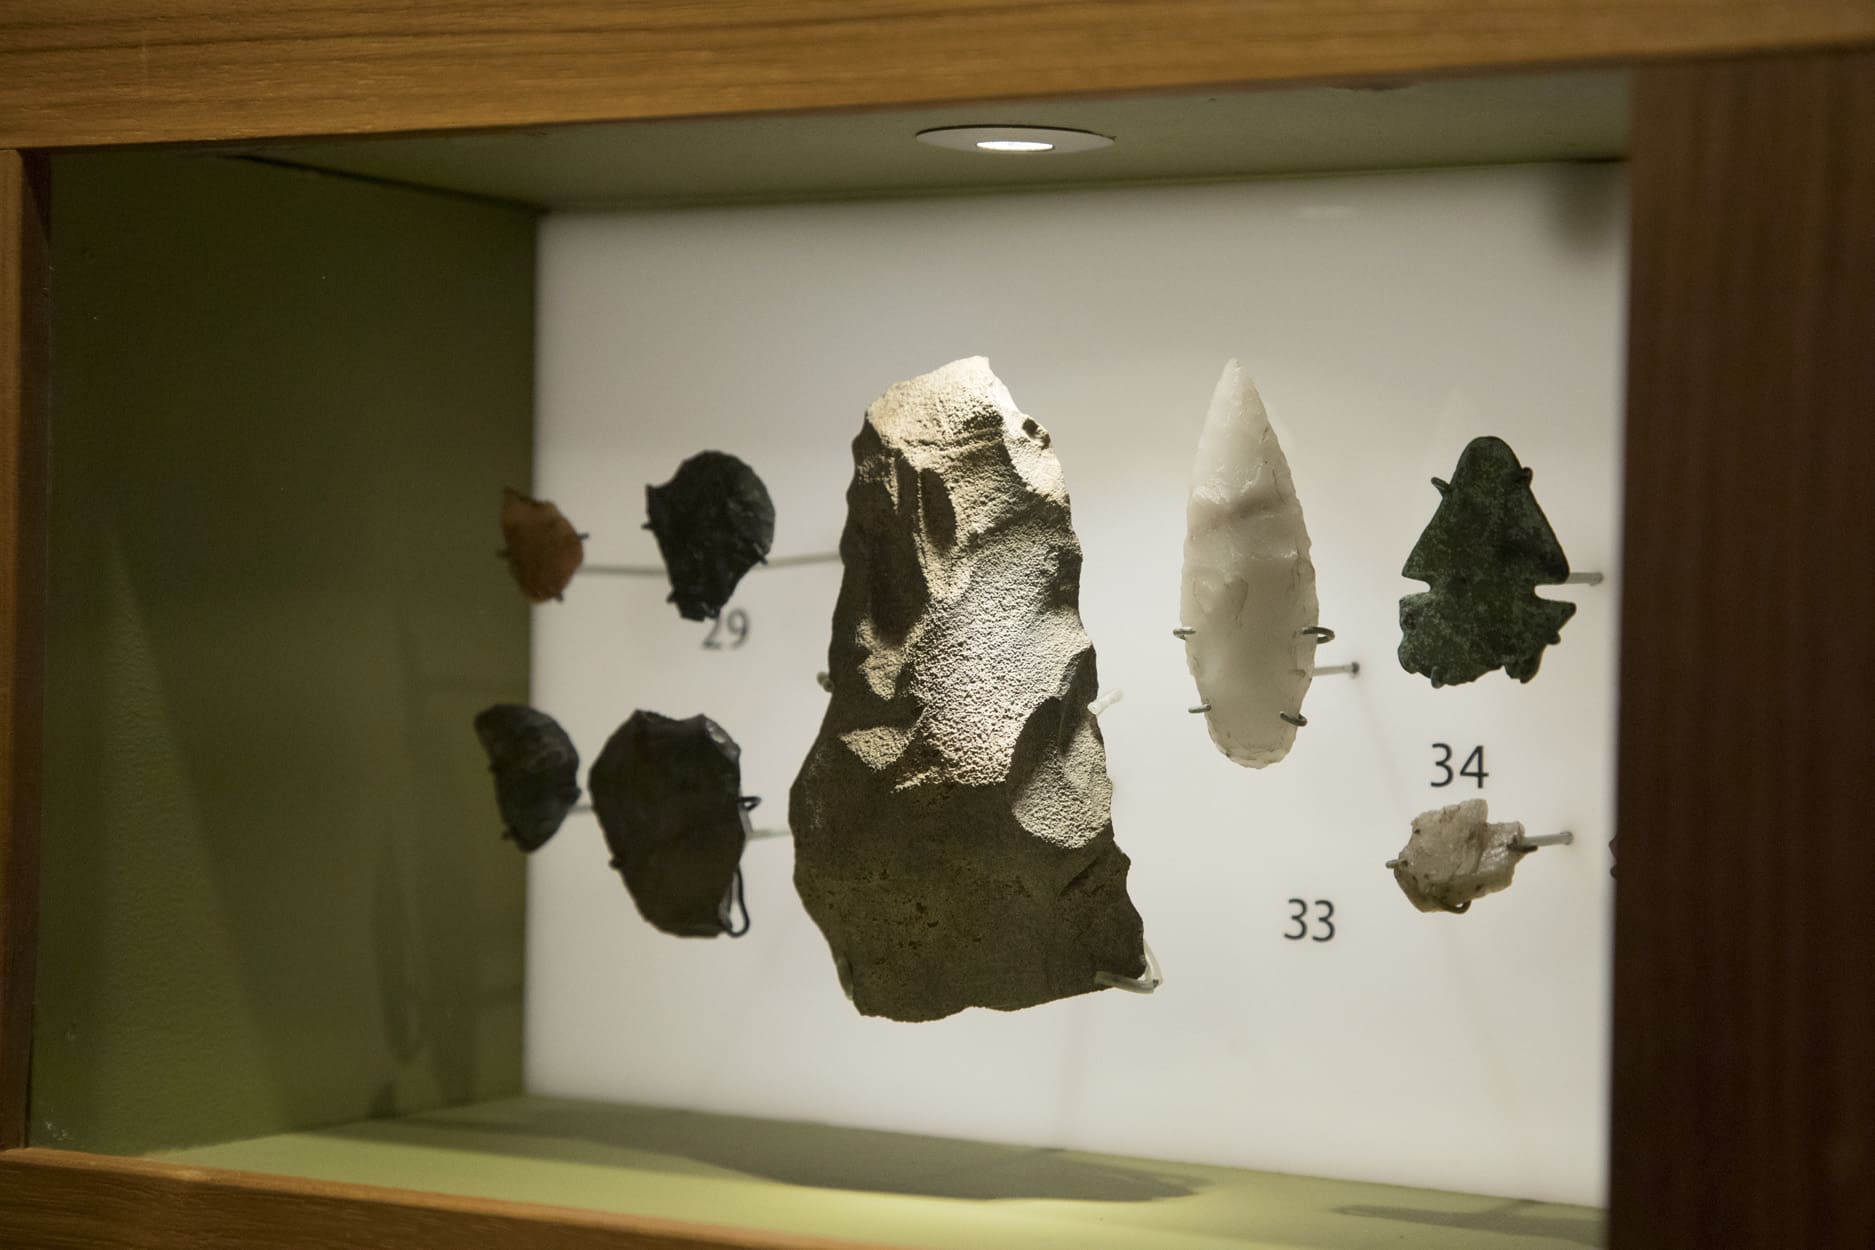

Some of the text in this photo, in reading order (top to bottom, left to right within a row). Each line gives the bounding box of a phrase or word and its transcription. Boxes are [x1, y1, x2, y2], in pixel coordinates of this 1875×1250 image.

[702, 607, 750, 650] 29
[1430, 742, 1489, 789] 34
[1283, 896, 1336, 943] 33
